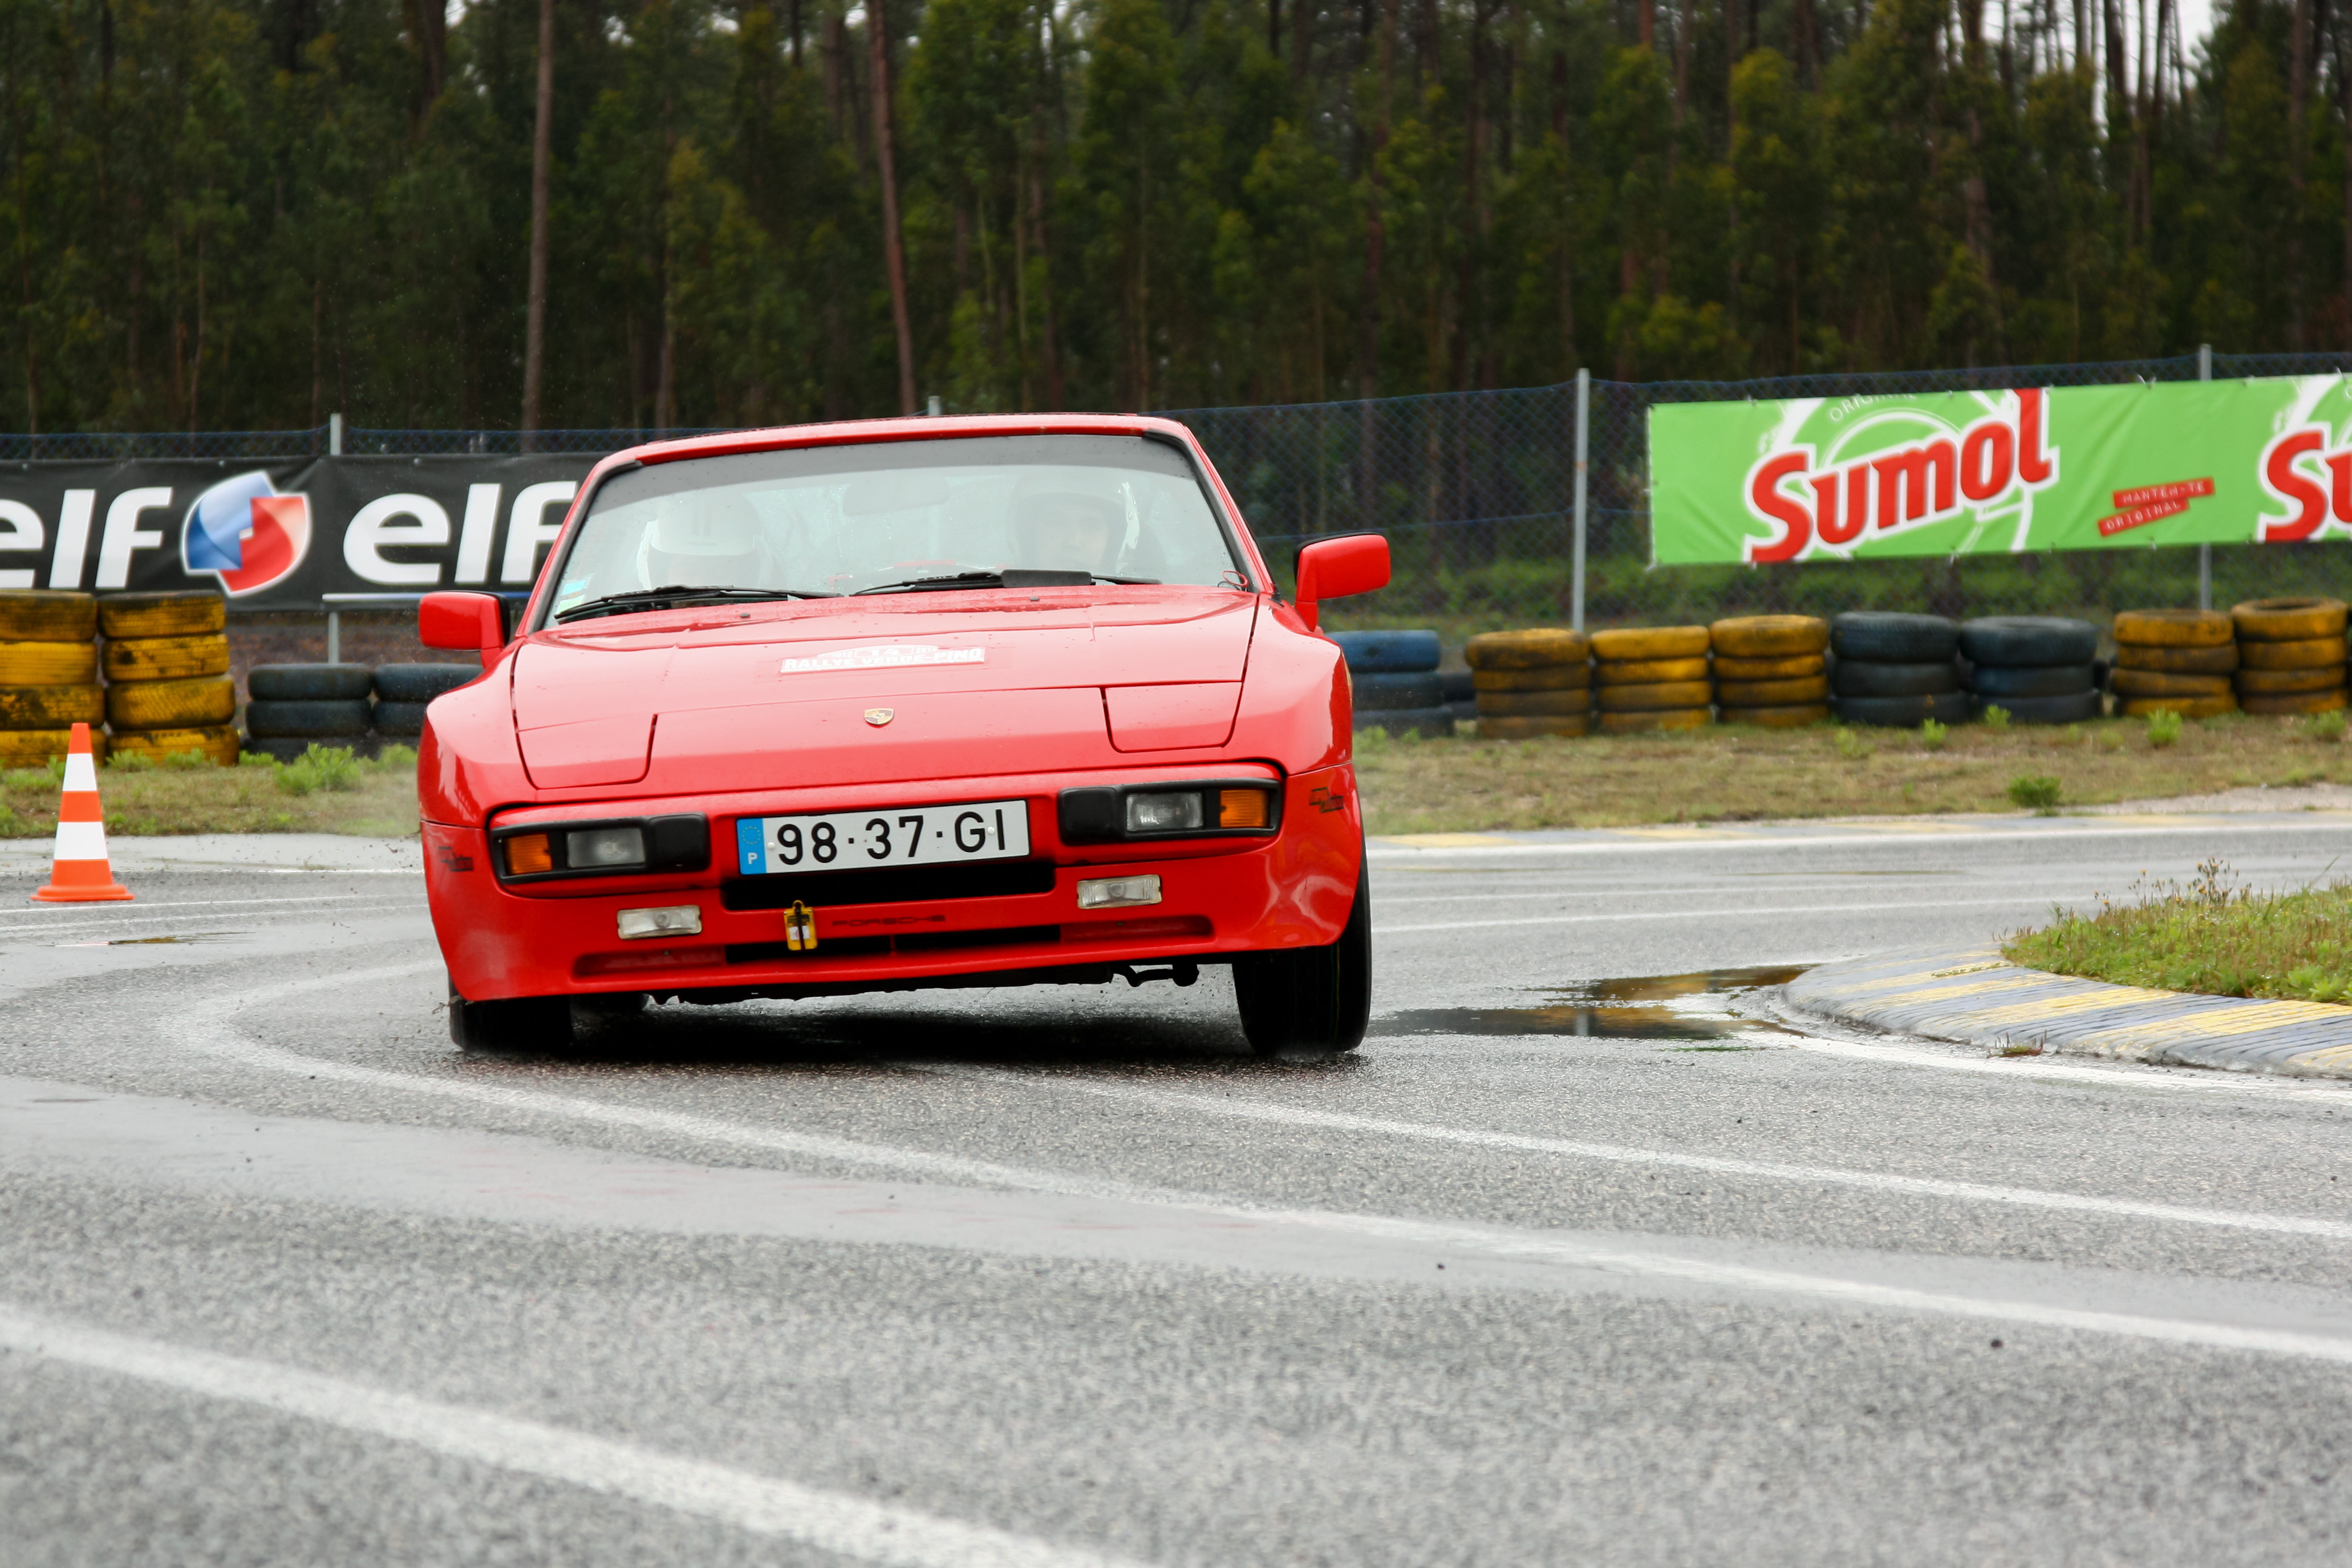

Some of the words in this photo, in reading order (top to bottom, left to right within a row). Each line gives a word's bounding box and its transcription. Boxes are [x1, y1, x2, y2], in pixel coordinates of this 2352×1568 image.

[1830, 393, 1917, 421] ORIG
[1752, 389, 2051, 562] Sumol
[2107, 500, 2181, 530] ORIGINAL
[343, 481, 577, 584] elf
[785, 658, 855, 669] RALLYE
[861, 648, 982, 664] VERDE-PINO
[868, 648, 899, 656] 14
[748, 852, 757, 864] P
[832, 915, 946, 927] PORSCHE
